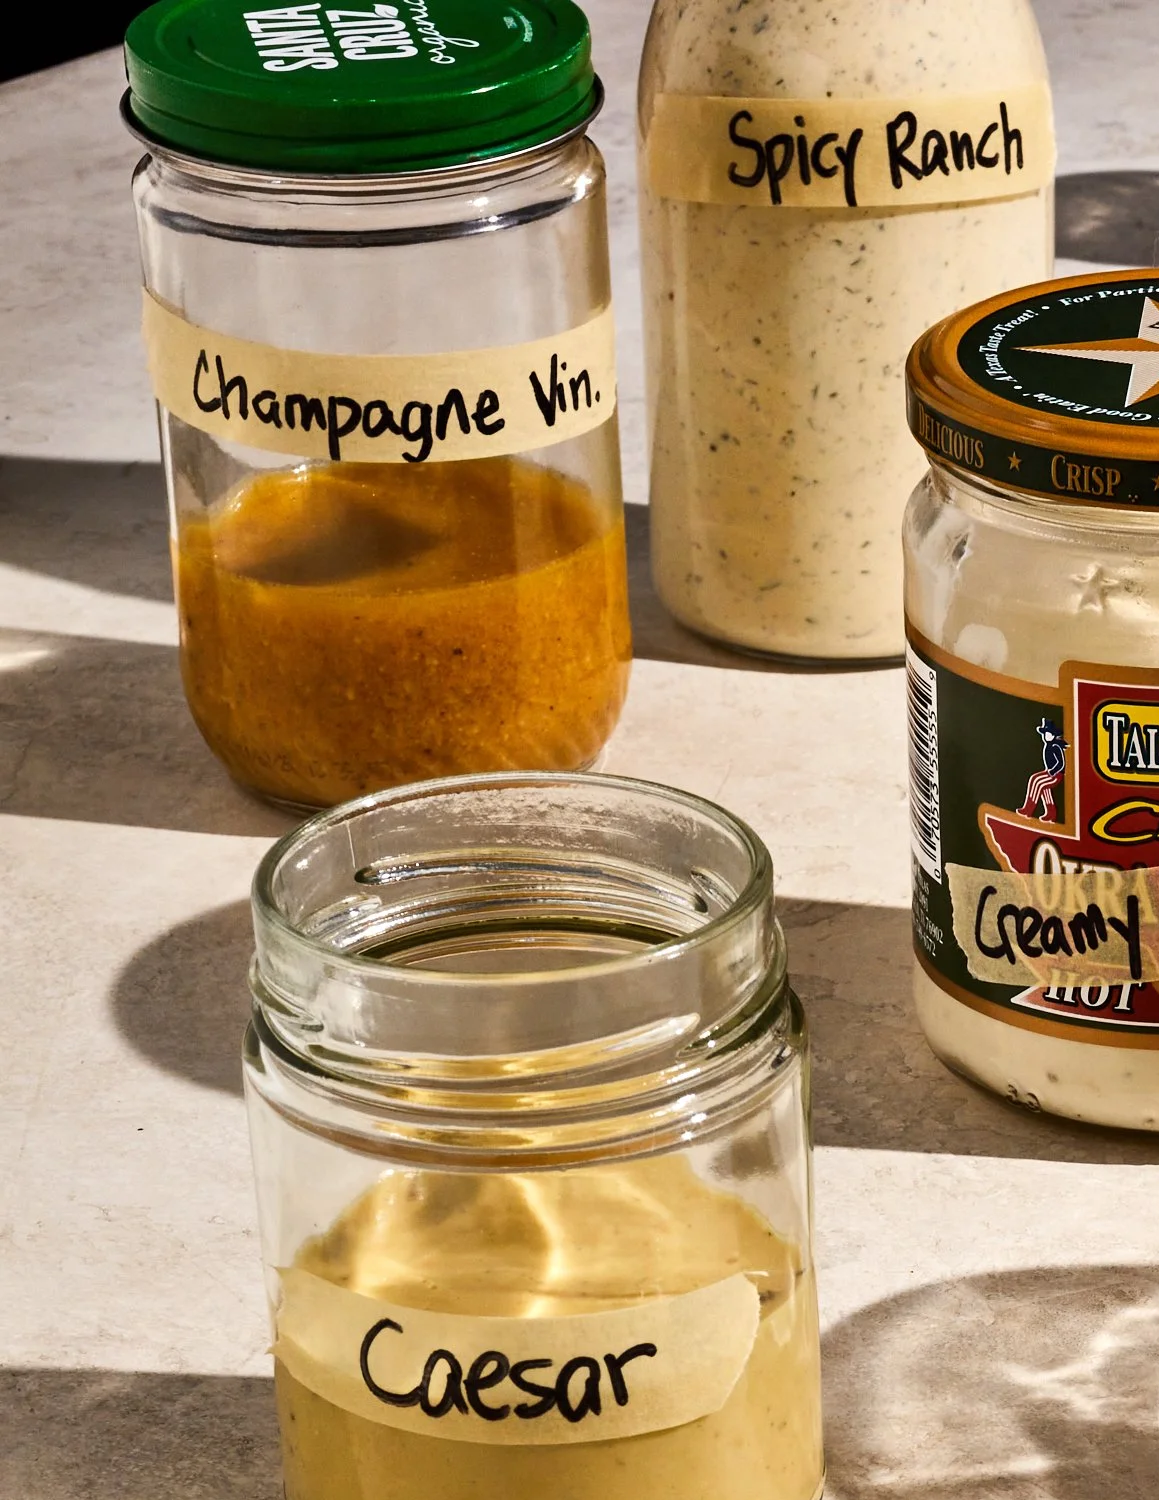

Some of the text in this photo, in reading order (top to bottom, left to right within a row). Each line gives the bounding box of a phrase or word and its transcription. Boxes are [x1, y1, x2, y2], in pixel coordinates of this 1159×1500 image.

[243, 2, 339, 72] SANTA
[325, 8, 419, 61] CRUZ
[727, 101, 1025, 208] Spicy Ranch
[978, 331, 1006, 353] Taste
[985, 352, 1008, 376] Texas
[1058, 293, 1094, 307] For
[1090, 406, 1153, 423] Good
[192, 349, 602, 463] Champagne Vin.
[917, 401, 985, 470] DELICIOUS
[1050, 453, 1122, 498] CRISP
[932, 868, 942, 880] 0
[974, 885, 1142, 980] Creamy
[1043, 966, 1143, 1012] HOT
[359, 1317, 659, 1423] Caesar
